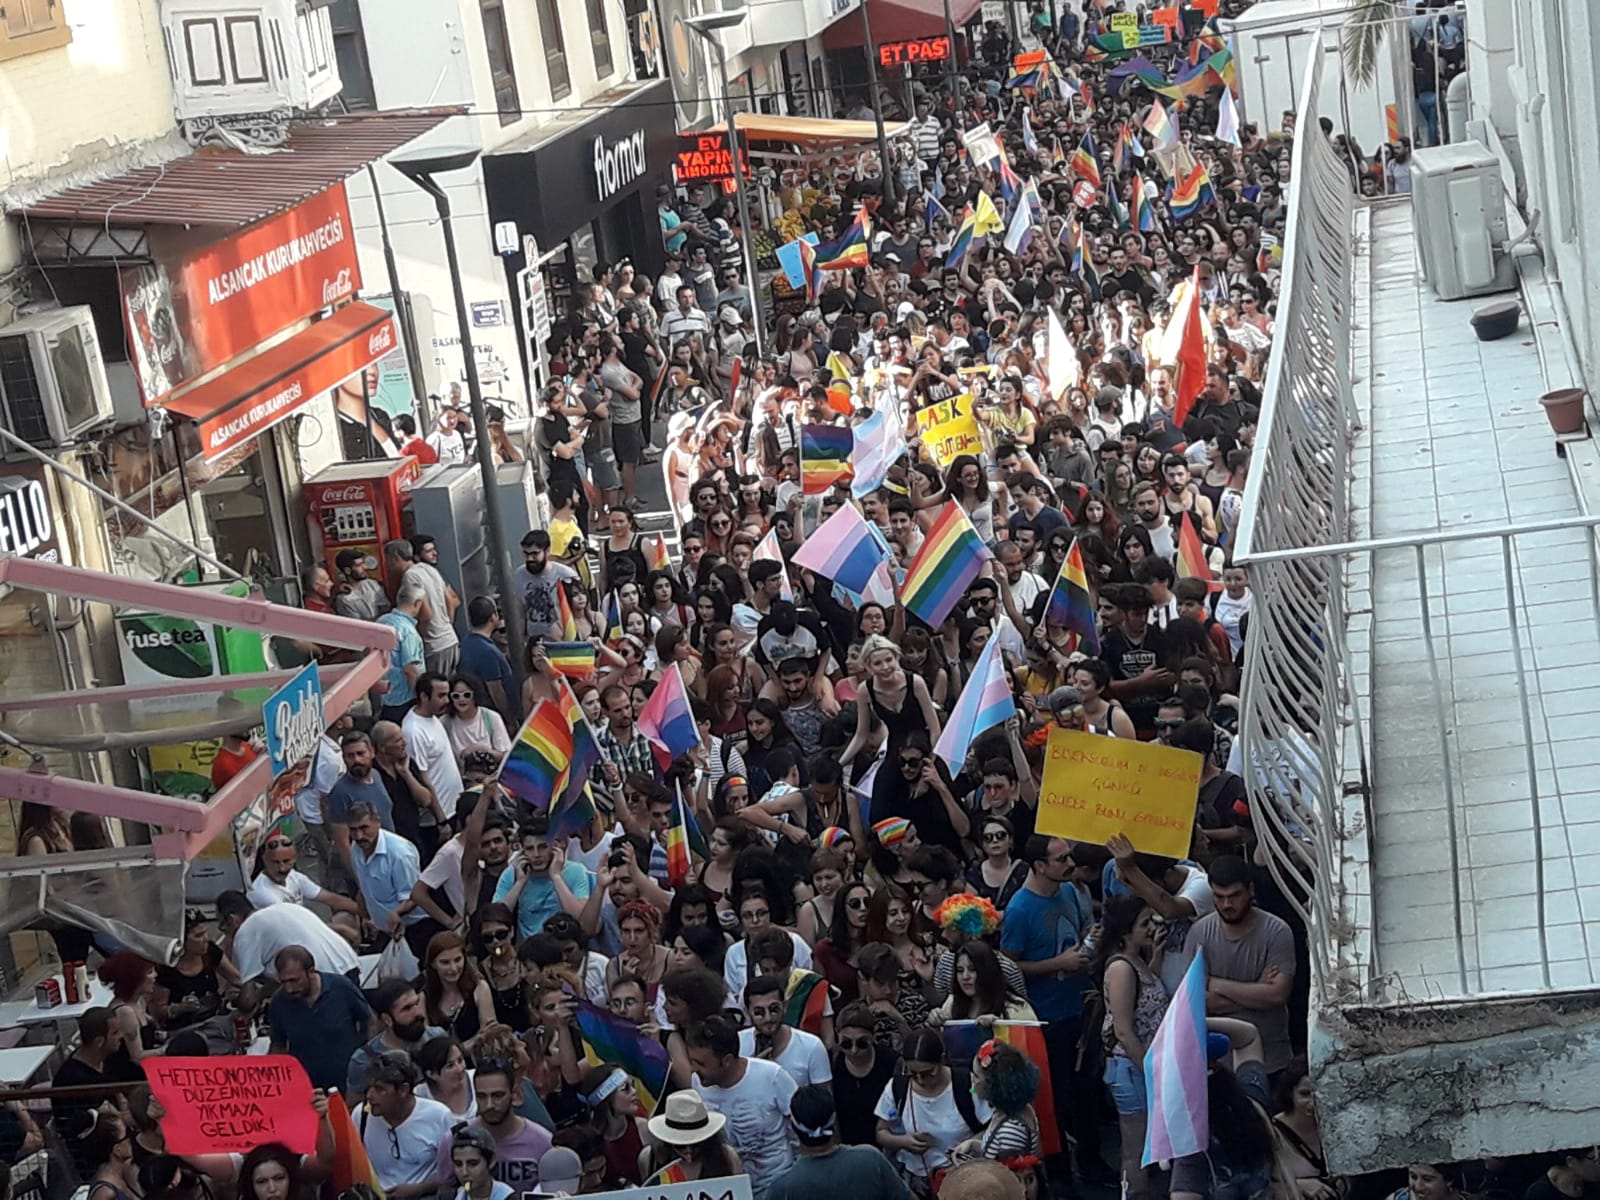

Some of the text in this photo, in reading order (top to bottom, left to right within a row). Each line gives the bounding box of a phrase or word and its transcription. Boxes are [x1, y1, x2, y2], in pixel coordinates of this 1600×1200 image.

[698, 136, 722, 151] EV
[594, 127, 646, 202] flormar
[208, 257, 266, 304] ALSANCAK
[210, 412, 250, 448] ALSANCAK
[322, 486, 365, 502] Coca-Cola
